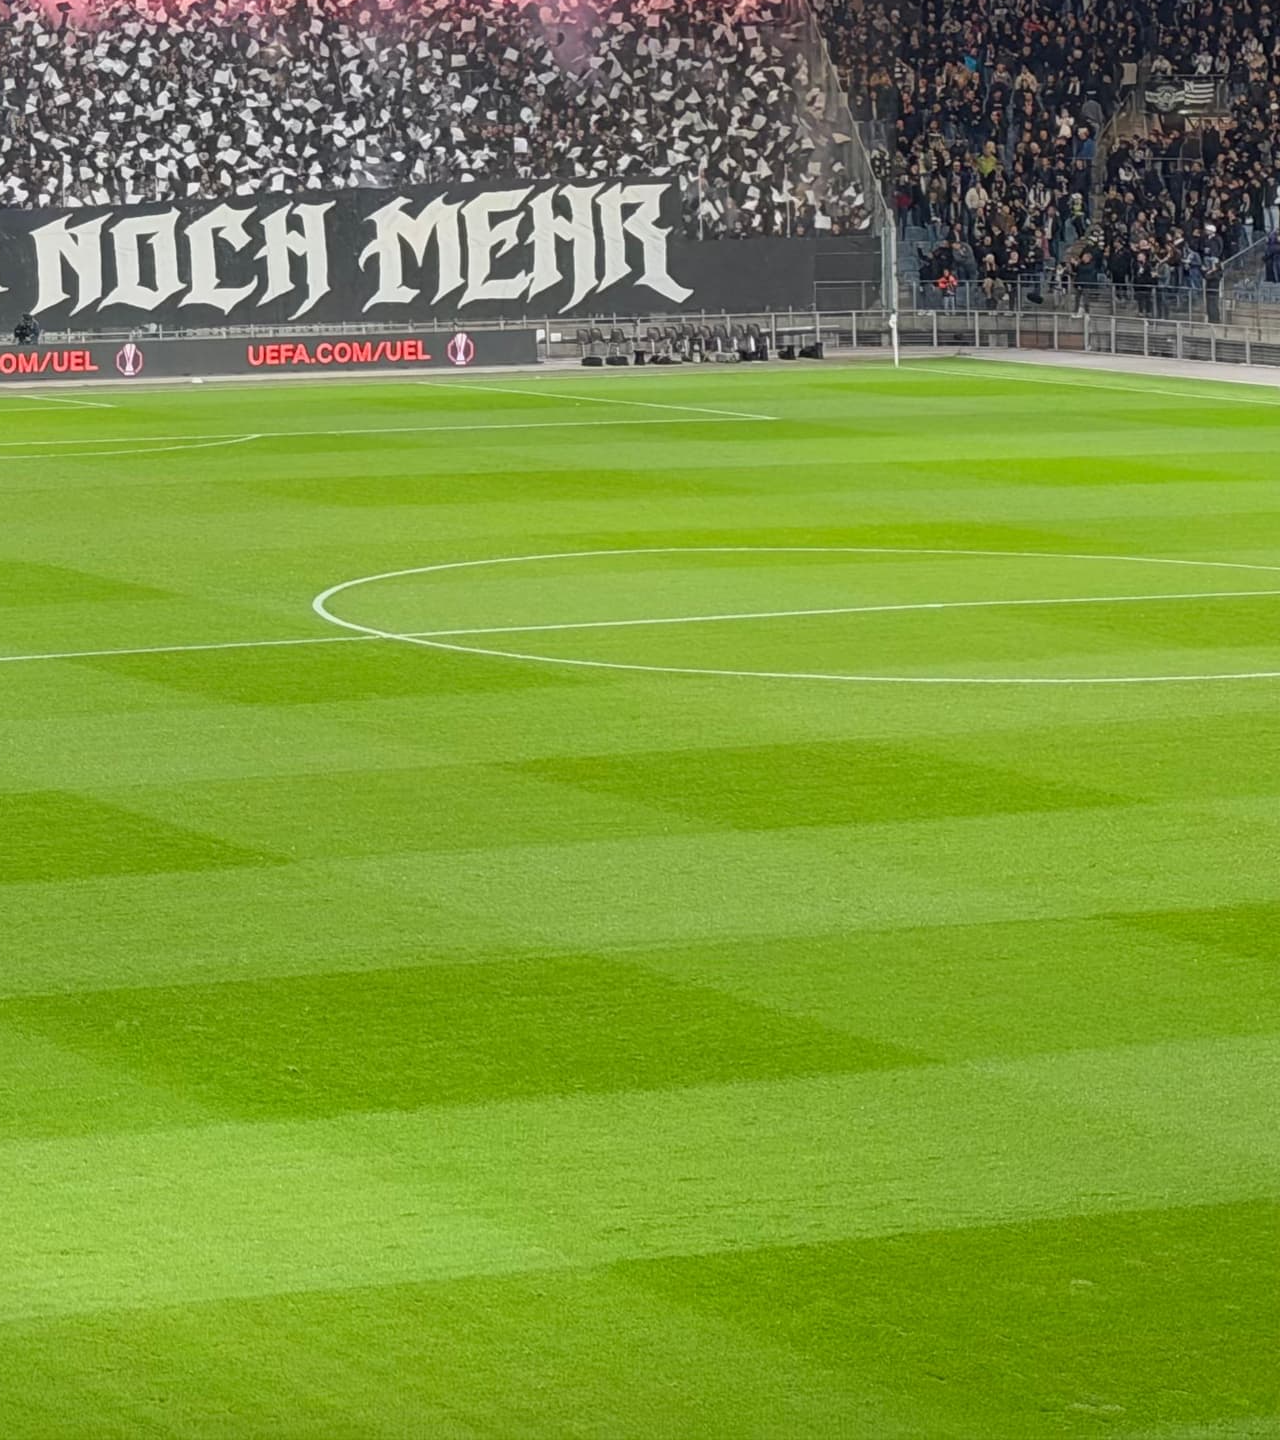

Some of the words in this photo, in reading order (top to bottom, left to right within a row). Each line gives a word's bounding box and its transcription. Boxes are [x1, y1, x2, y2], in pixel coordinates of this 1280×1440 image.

[28, 201, 336, 321] NOCH
[357, 181, 695, 313] MEHR
[247, 339, 430, 366] UEFA.COM/UEL
